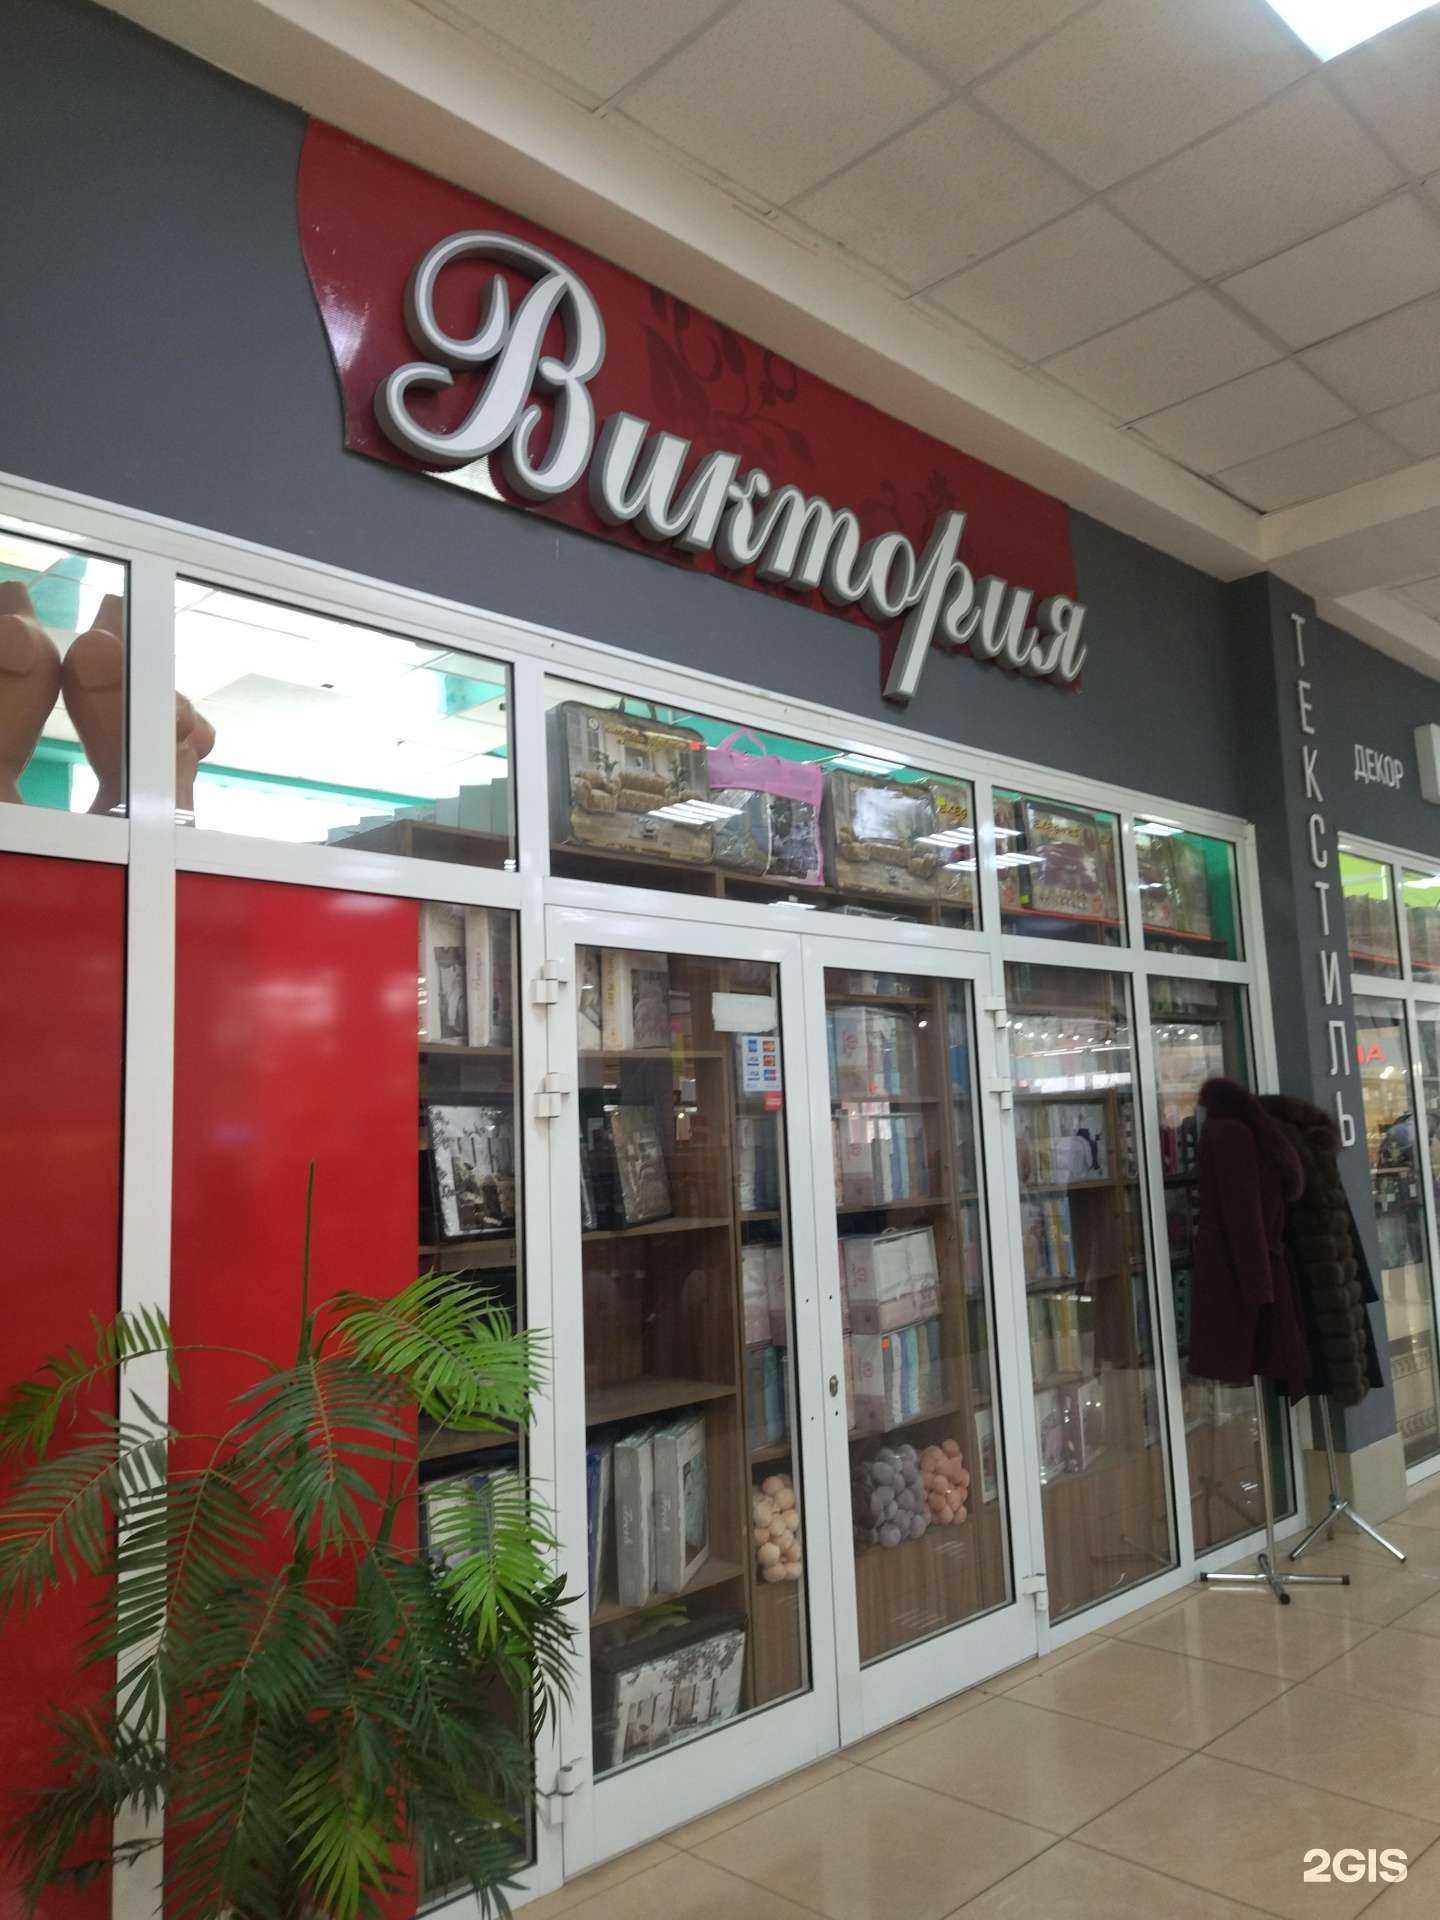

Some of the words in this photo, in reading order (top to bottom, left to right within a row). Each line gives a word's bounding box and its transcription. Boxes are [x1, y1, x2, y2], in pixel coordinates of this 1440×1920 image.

[374, 229, 1088, 702] Виктория
[1290, 612, 1357, 1148] ТЕКСТИЛЬ
[1354, 744, 1404, 791] ДЕКОР
